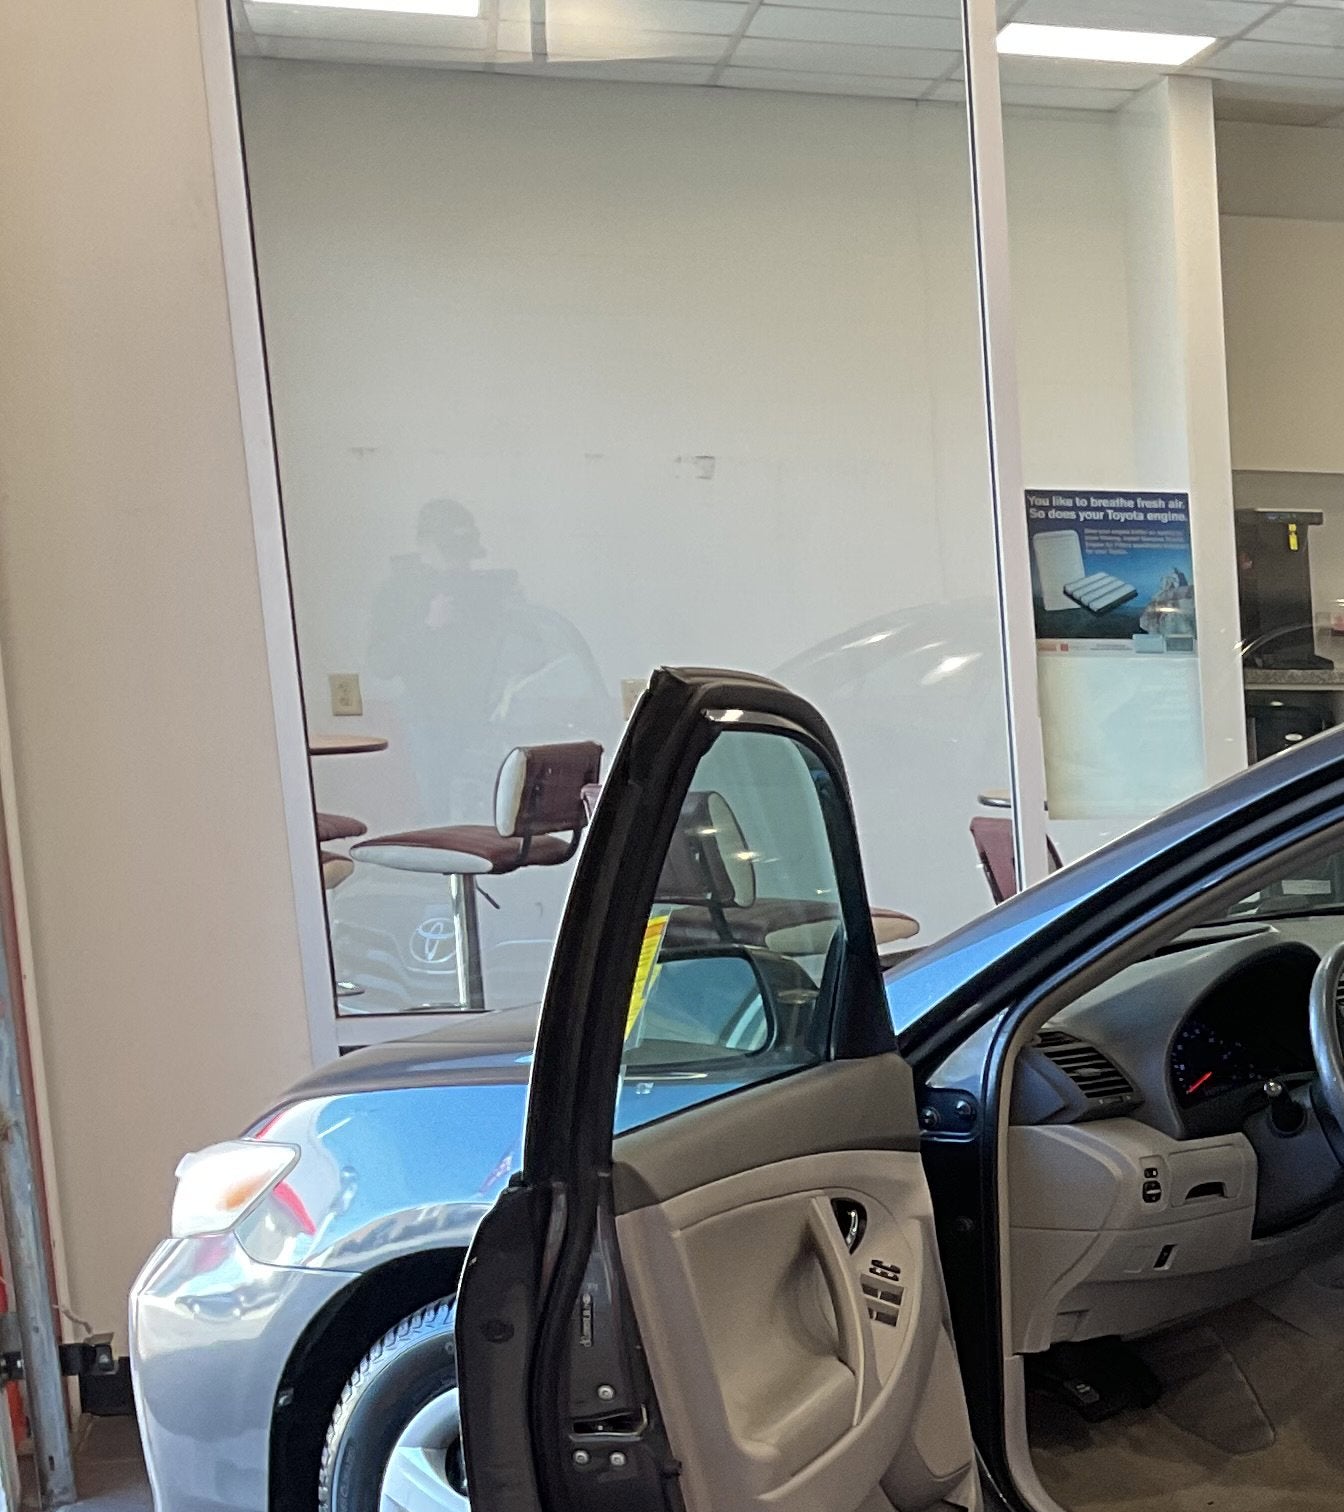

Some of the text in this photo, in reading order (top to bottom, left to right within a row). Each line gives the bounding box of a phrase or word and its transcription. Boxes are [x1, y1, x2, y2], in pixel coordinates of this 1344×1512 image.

[1027, 496, 1049, 506] You
[1052, 495, 1073, 506] like
[1075, 496, 1088, 507] to
[1090, 496, 1135, 508] breathe
[1137, 497, 1165, 508] fresh
[1029, 508, 1045, 518] So
[1048, 509, 1077, 519] does
[1079, 509, 1104, 521] your
[1106, 509, 1144, 522] Toyota
